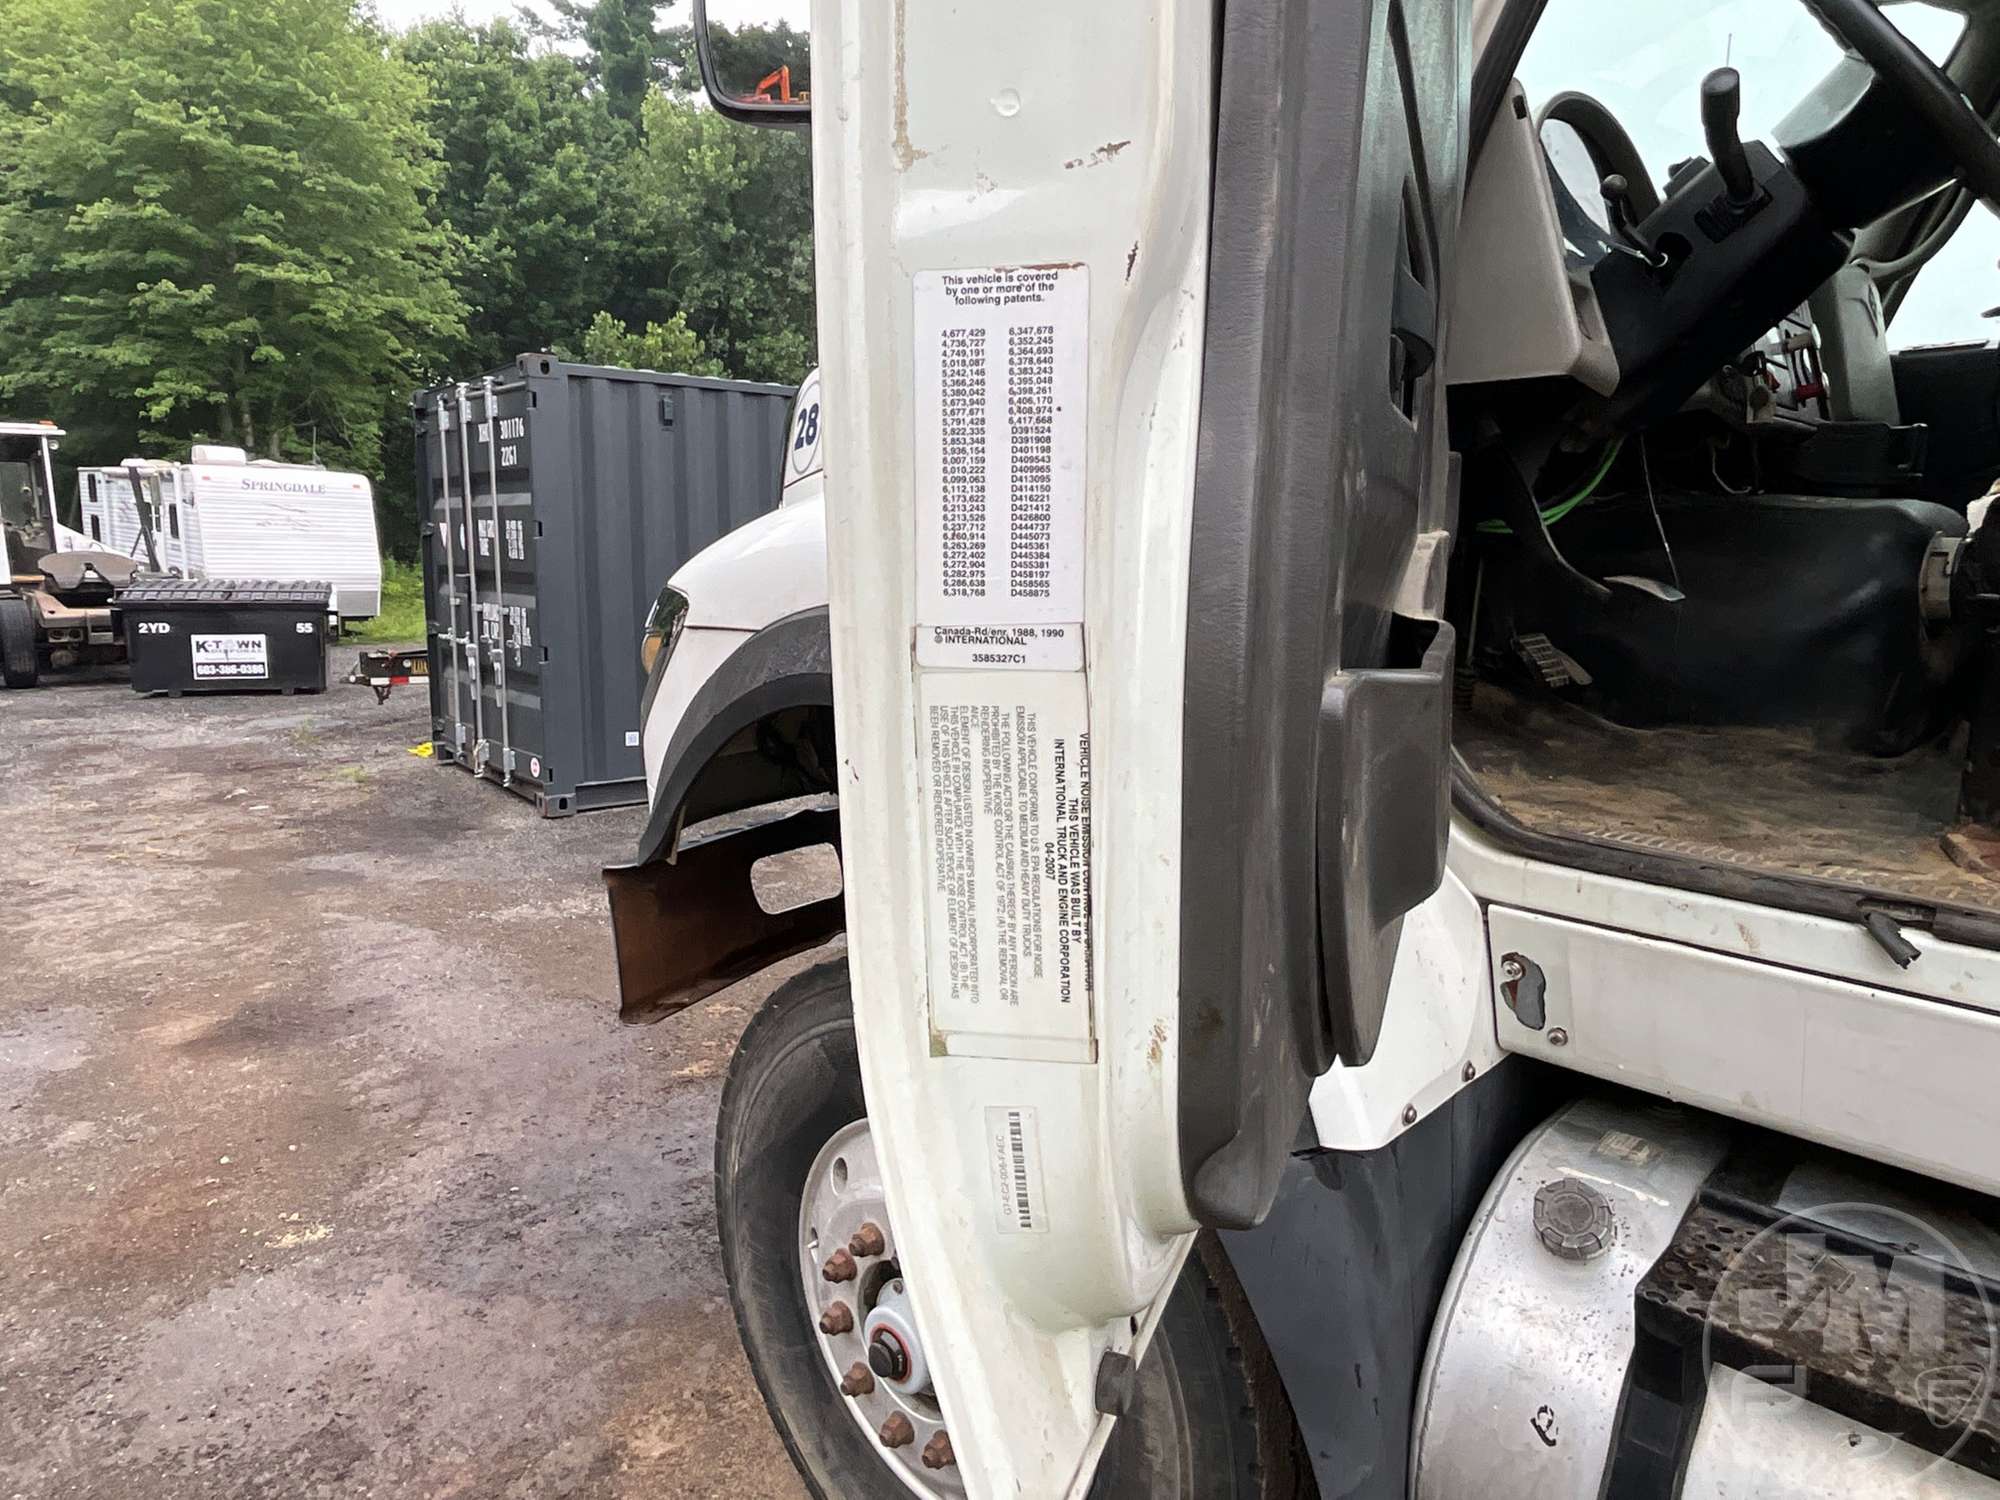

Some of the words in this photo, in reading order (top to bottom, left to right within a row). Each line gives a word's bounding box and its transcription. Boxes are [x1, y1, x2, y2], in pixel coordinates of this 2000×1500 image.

[942, 276, 963, 284] This
[967, 274, 1001, 283] vehicle
[1005, 272, 1013, 282] is
[1017, 271, 1058, 282] covered
[946, 286, 957, 296] by
[996, 285, 1022, 293] more
[1025, 282, 1036, 292] of
[1038, 282, 1054, 291] the
[955, 296, 1000, 305] following
[1004, 294, 1045, 305] patents.
[500, 417, 524, 439] 301176
[795, 403, 819, 451] 28
[138, 623, 170, 633] 2YD
[296, 623, 313, 633] 55
[1012, 628, 1037, 638] 1988,
[1042, 629, 1064, 637] 1990
[945, 636, 1027, 645] INTERNATIONAL
[972, 654, 1026, 663] 3585327C1
[1080, 733, 1089, 778] VEHICLE
[1055, 738, 1066, 822] INTERNATIONAL
[1069, 798, 1078, 821] THIS
[1057, 826, 1067, 861] TRUCK
[1069, 824, 1079, 868] VEHICLE
[1045, 842, 1055, 880] 04-2007
[1058, 864, 1067, 885] AND
[1070, 872, 1080, 894] WAS
[1058, 888, 1068, 926] ENGINE
[1071, 898, 1081, 927] BUILT
[1072, 930, 1081, 944] BY
[1059, 930, 1070, 1003] CORPORATION
